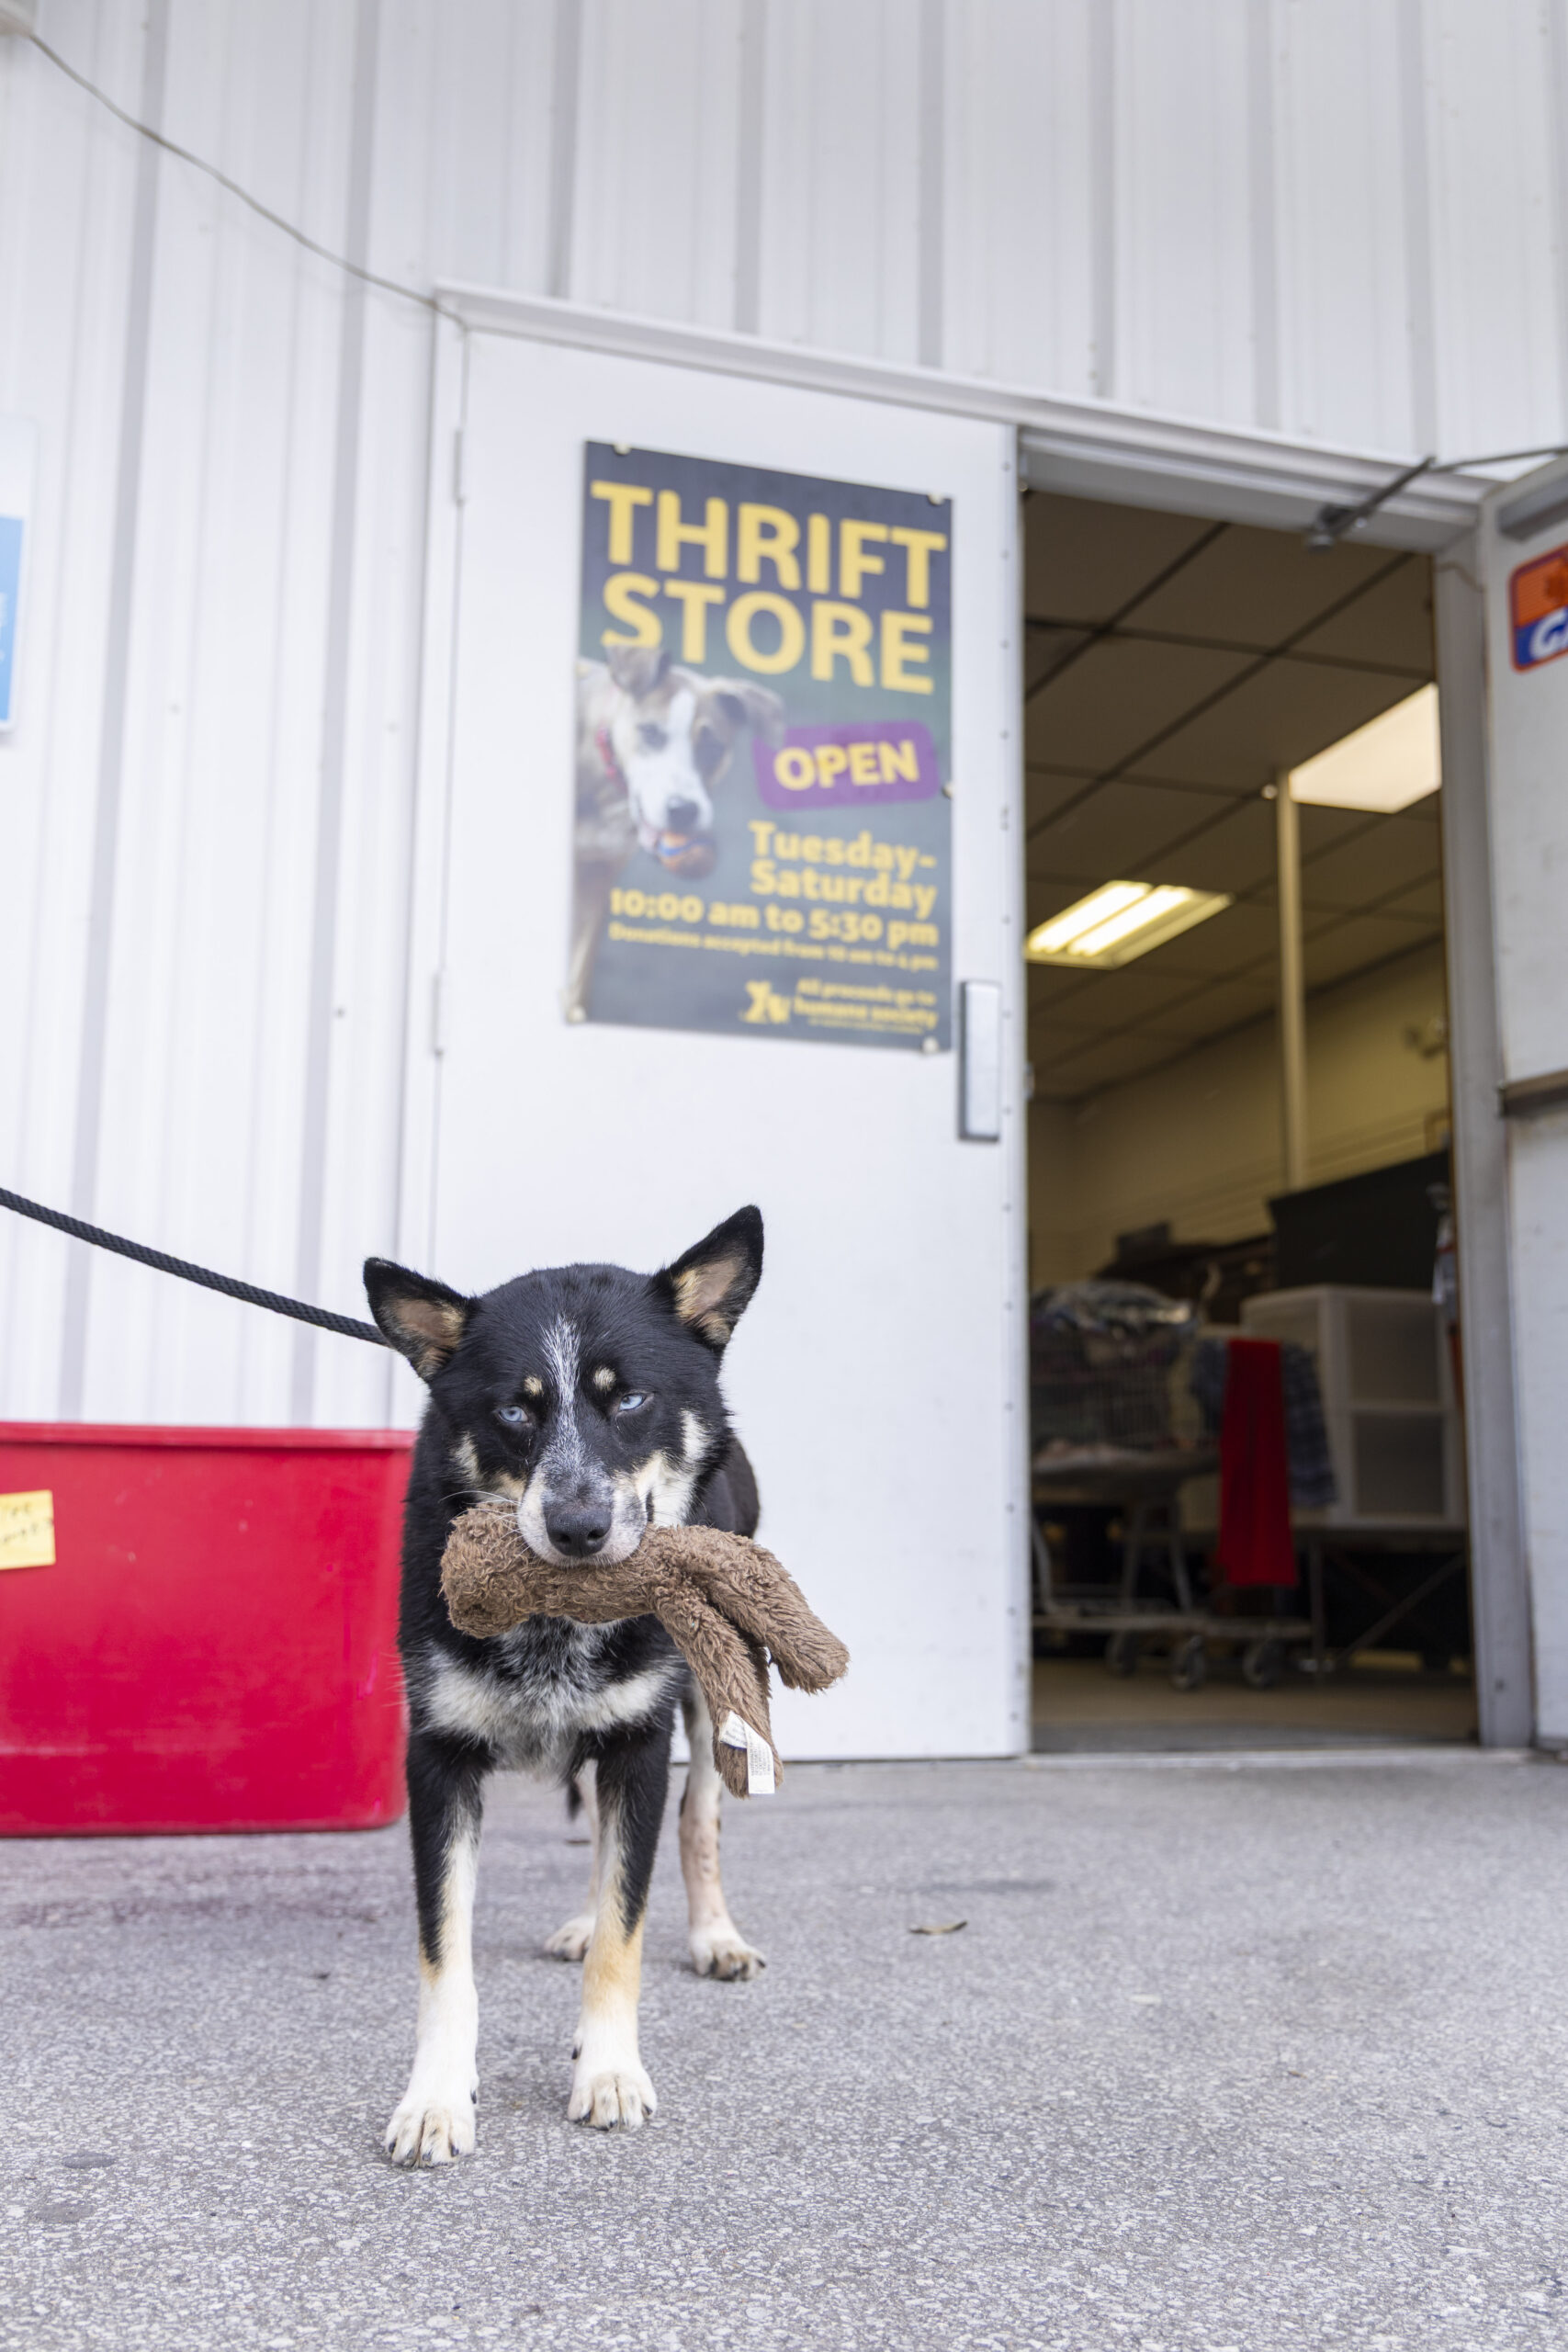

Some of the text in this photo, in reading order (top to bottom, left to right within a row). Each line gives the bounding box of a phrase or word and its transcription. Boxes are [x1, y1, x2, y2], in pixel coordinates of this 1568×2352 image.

[591, 480, 947, 608] THRIFT
[601, 571, 934, 695] STORE
[773, 740, 919, 791] OPEN
[748, 820, 937, 881] Tuesday-
[610, 888, 939, 951] 10:00 am to 5:30 pm
[750, 858, 938, 921] Saturday
[608, 922, 701, 949] Donations
